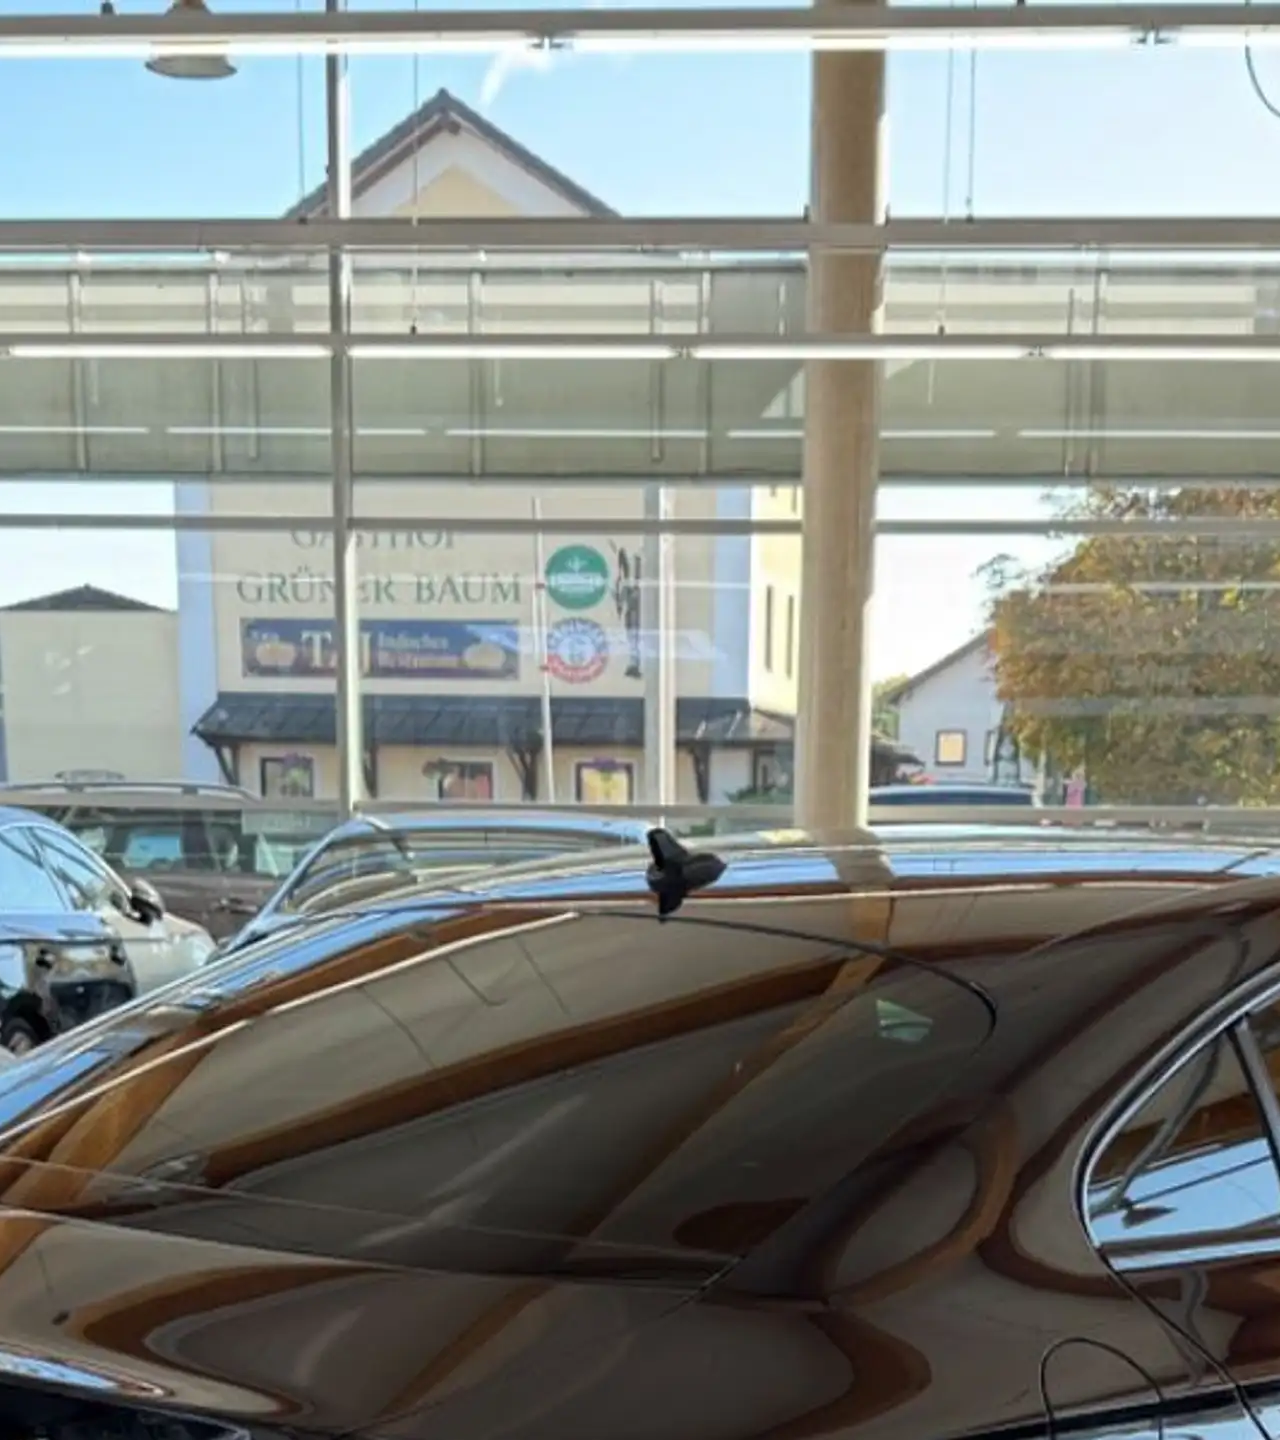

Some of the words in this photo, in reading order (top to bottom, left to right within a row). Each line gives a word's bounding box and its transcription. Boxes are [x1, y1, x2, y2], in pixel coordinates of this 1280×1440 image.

[291, 531, 455, 550] GTHOF
[414, 572, 521, 605] BAUM
[300, 629, 373, 677] TJ
